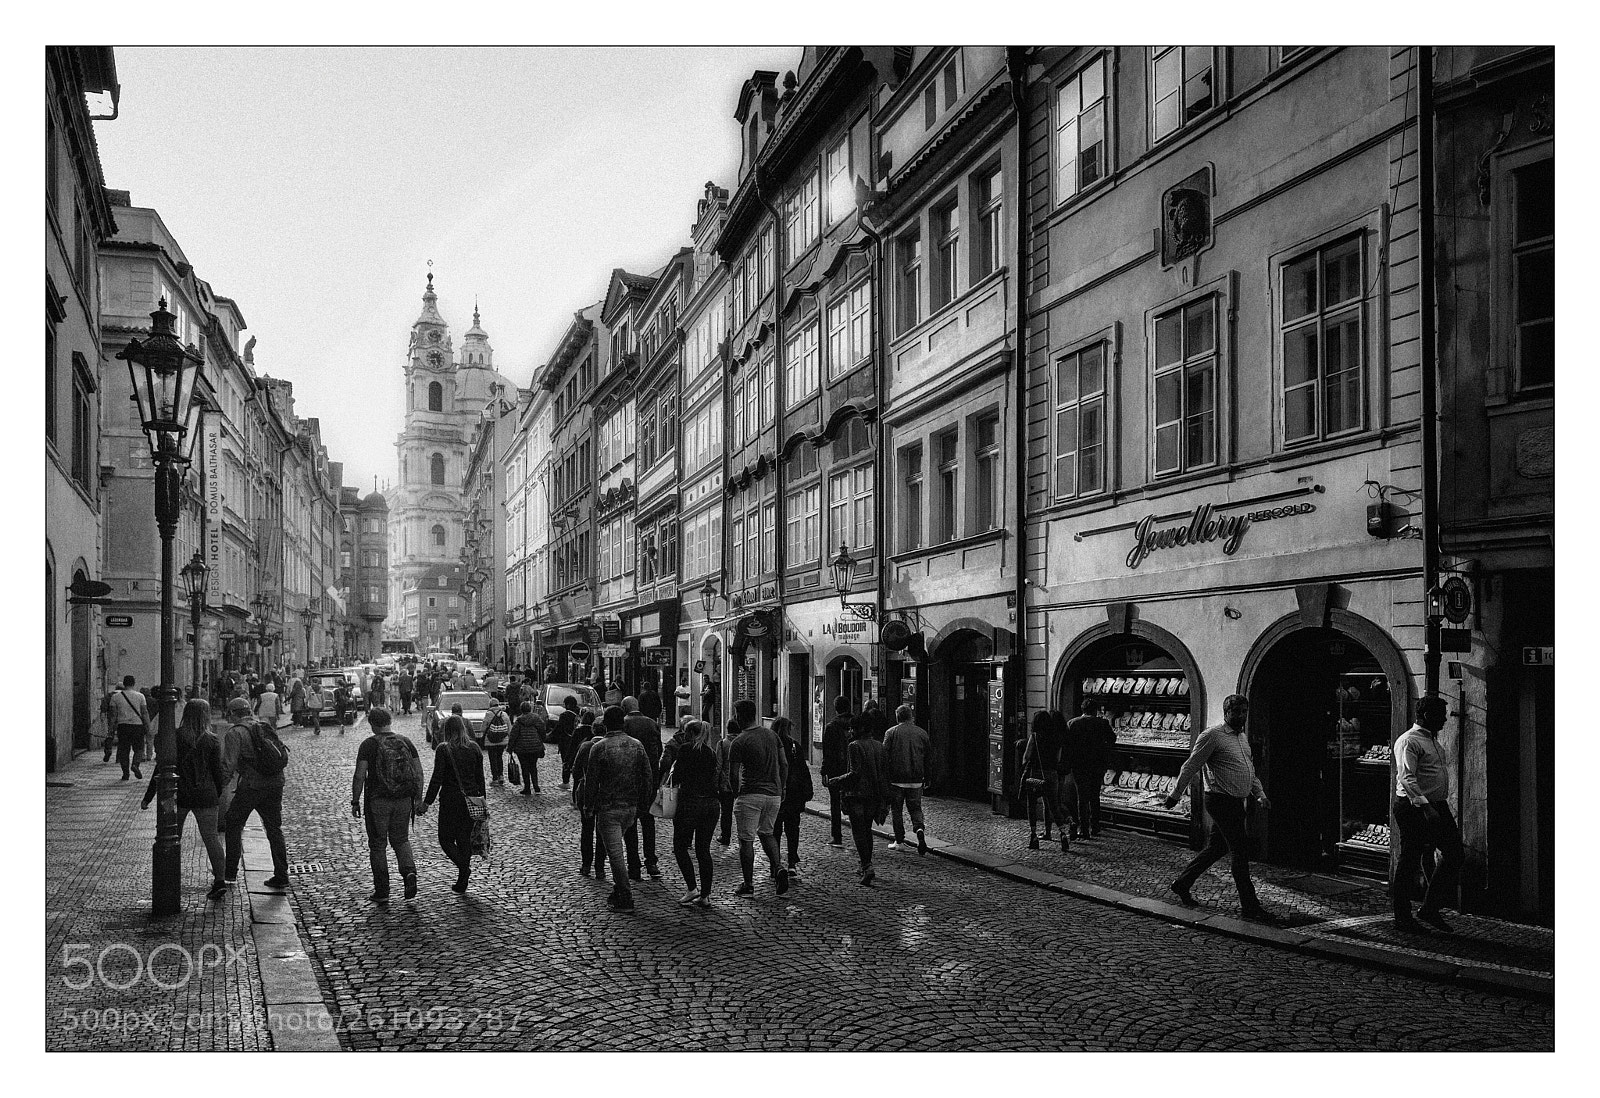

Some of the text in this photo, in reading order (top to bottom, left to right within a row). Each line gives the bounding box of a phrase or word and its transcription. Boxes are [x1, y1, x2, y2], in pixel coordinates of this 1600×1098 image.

[209, 432, 220, 597] DESIGN HOTEL DOMUS BALTHASAR
[1125, 502, 1249, 569] Jewellery
[822, 621, 867, 635] LA BOUDOIR
